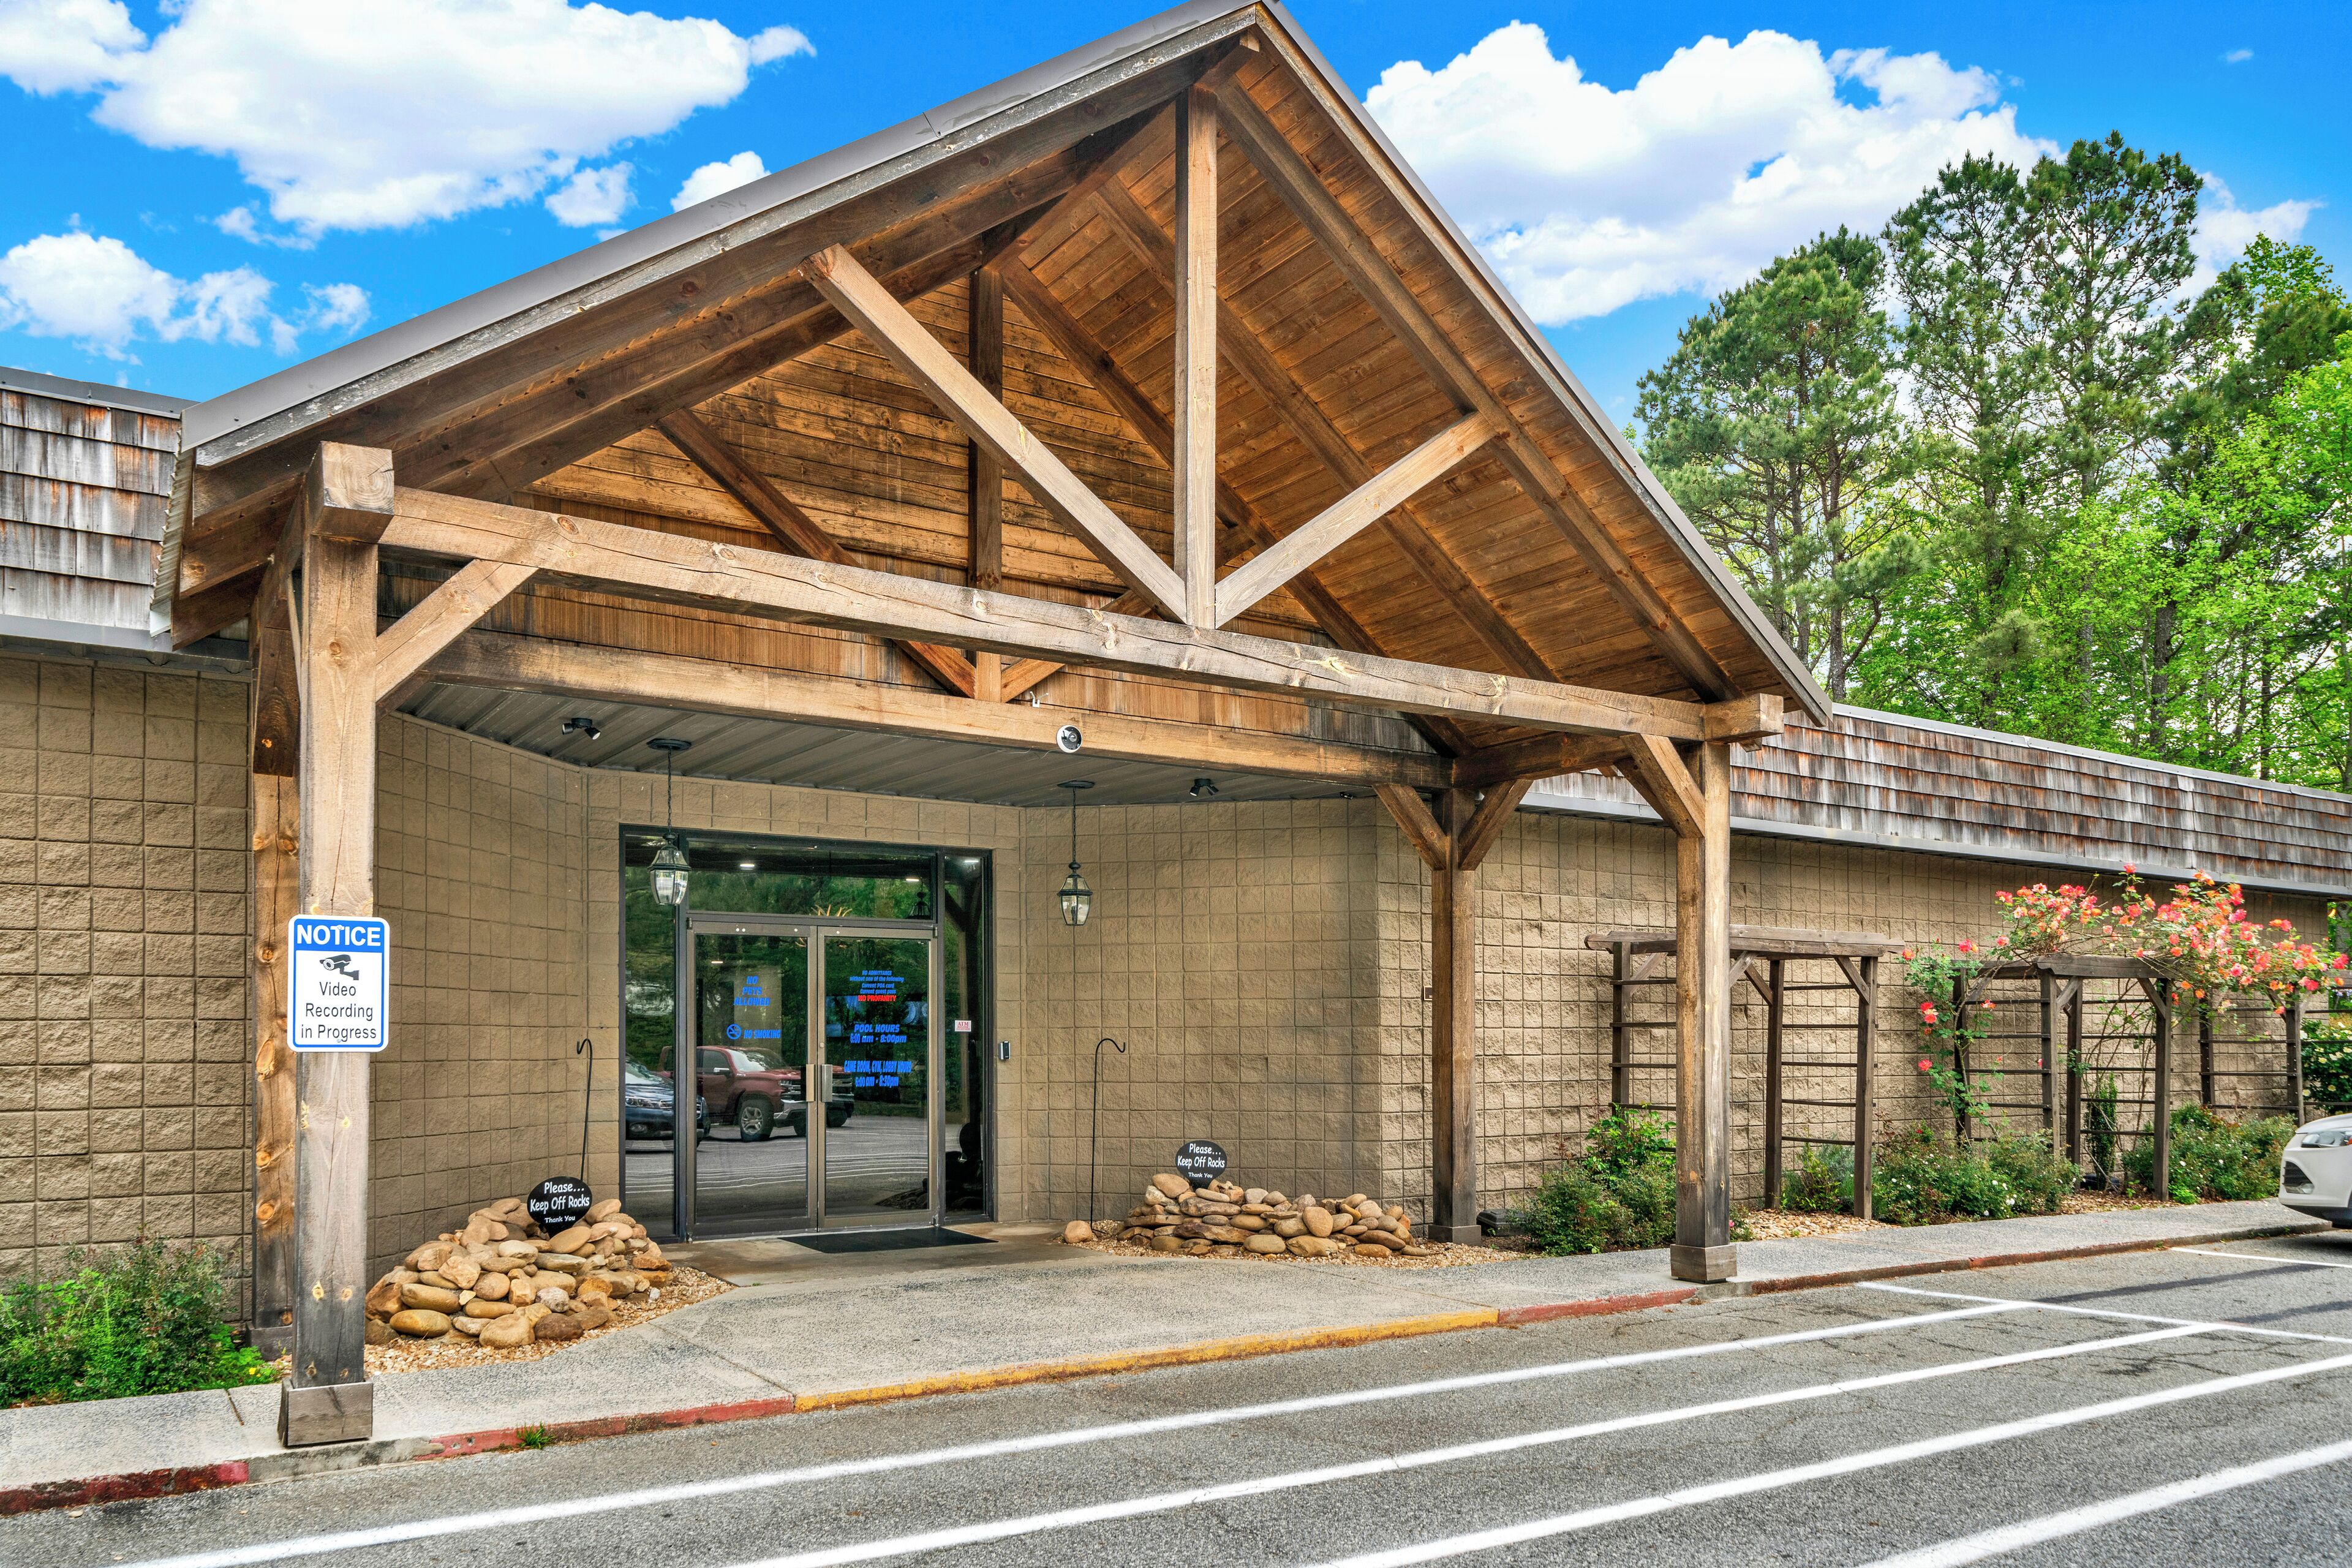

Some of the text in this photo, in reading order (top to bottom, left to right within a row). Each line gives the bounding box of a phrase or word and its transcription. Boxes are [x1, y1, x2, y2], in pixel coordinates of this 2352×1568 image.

[296, 924, 381, 946] NOTICE
[746, 975, 759, 985] NO
[319, 981, 356, 997] Video
[742, 986, 763, 995] PETS
[733, 997, 771, 1006] ALLOWED
[306, 1003, 373, 1021] Recording
[301, 1024, 377, 1042] in Progress
[744, 1030, 781, 1039] NO SMOKING
[854, 1024, 900, 1033] POOL HOURS
[850, 1033, 861, 1043] 6:00
[880, 1035, 907, 1044] 8:00pm
[844, 1060, 912, 1074] GAME ROOM, GYM, LOBBY HOURS
[855, 1077, 865, 1087] 6:00
[865, 1077, 875, 1087] am
[879, 1075, 899, 1088] 8:30pm
[1189, 1143, 1221, 1155] Please...
[1177, 1155, 1225, 1169] Keep Off Rocks
[544, 1181, 584, 1194] Please...
[530, 1194, 590, 1214] Keep Off Rocks
